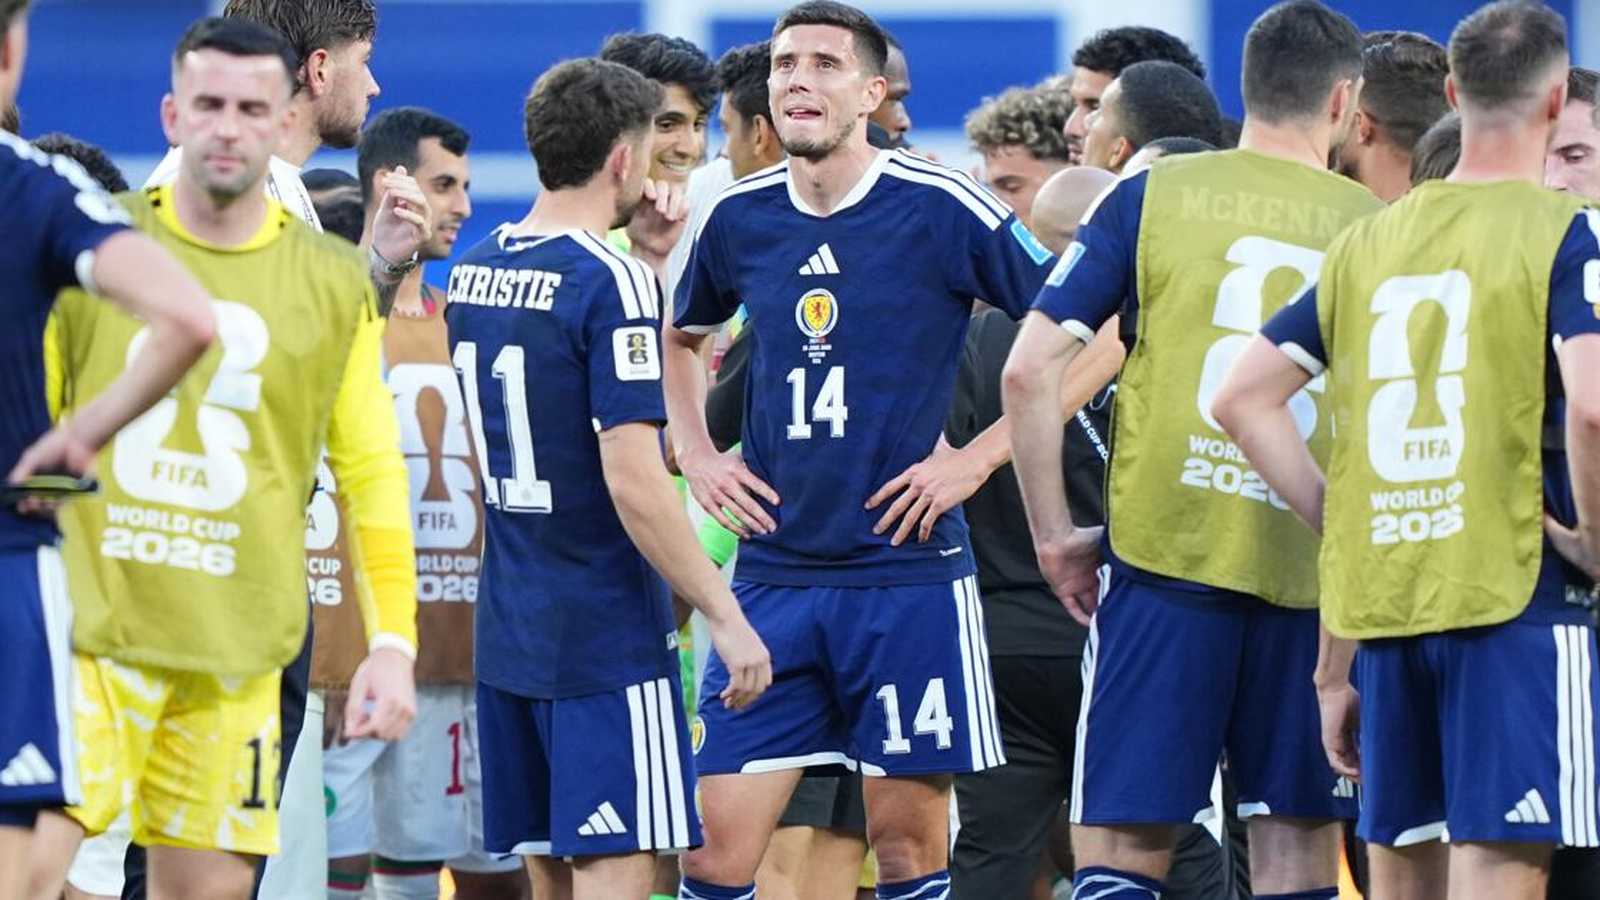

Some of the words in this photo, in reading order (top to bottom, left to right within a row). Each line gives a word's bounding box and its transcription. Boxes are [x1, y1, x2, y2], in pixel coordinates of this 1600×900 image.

[447, 264, 562, 311] CHRISTIE
[786, 366, 849, 439] 14
[453, 341, 552, 514] 11
[1189, 434, 1250, 464] WORL
[1403, 438, 1451, 461] FIFA
[152, 461, 209, 489] FIFA
[1370, 488, 1443, 511] WORLD
[106, 503, 190, 534] WORLD
[192, 518, 242, 541] CUP
[418, 511, 458, 531] FIFA
[100, 527, 237, 577] 2026
[308, 557, 342, 576] CUP
[418, 554, 453, 573] RLD
[416, 574, 479, 603] 026
[876, 677, 953, 755] 14
[445, 721, 465, 796] 1
